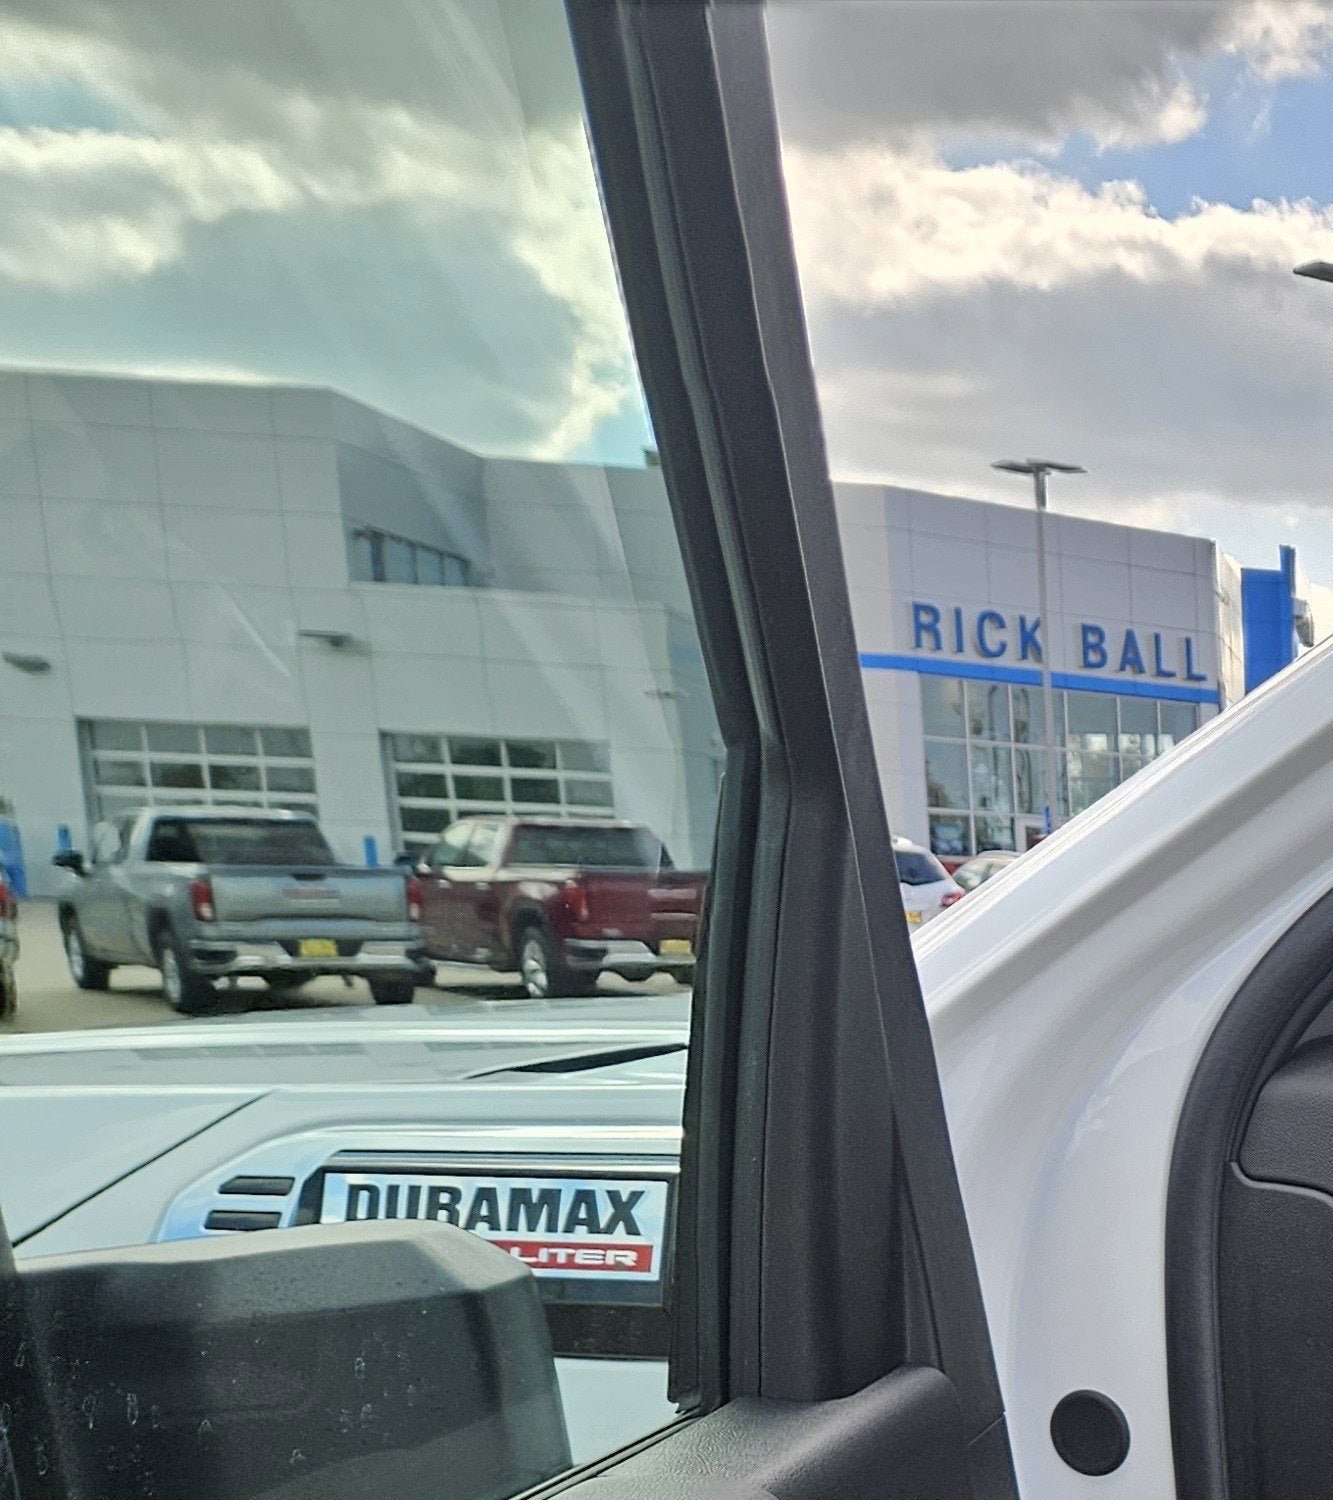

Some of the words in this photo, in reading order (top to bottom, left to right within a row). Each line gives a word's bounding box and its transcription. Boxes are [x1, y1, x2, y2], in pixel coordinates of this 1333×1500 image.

[911, 601, 1045, 661] RICK
[1080, 622, 1208, 682] BALL
[347, 1183, 647, 1236] DURAMAX
[510, 1246, 637, 1267] LITER
